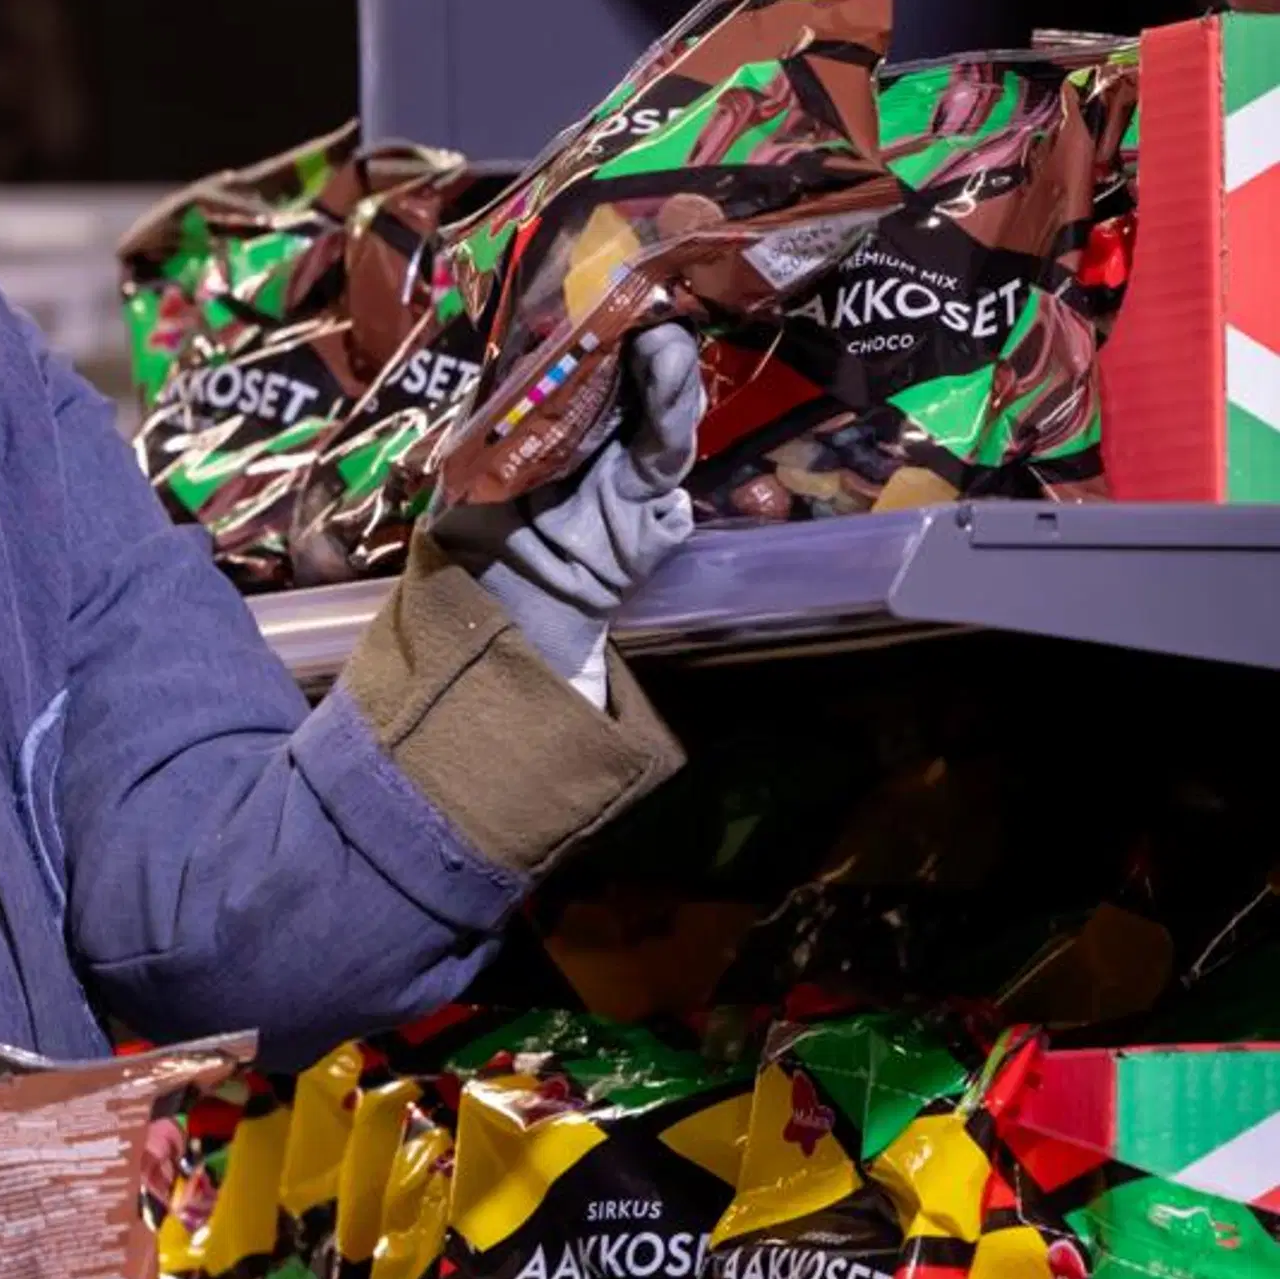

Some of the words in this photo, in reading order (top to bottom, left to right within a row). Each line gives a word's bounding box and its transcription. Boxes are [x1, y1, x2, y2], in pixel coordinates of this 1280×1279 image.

[921, 268, 957, 290] MIX
[847, 333, 915, 354] CHOCO
[587, 1200, 664, 1222] SIRKUS
